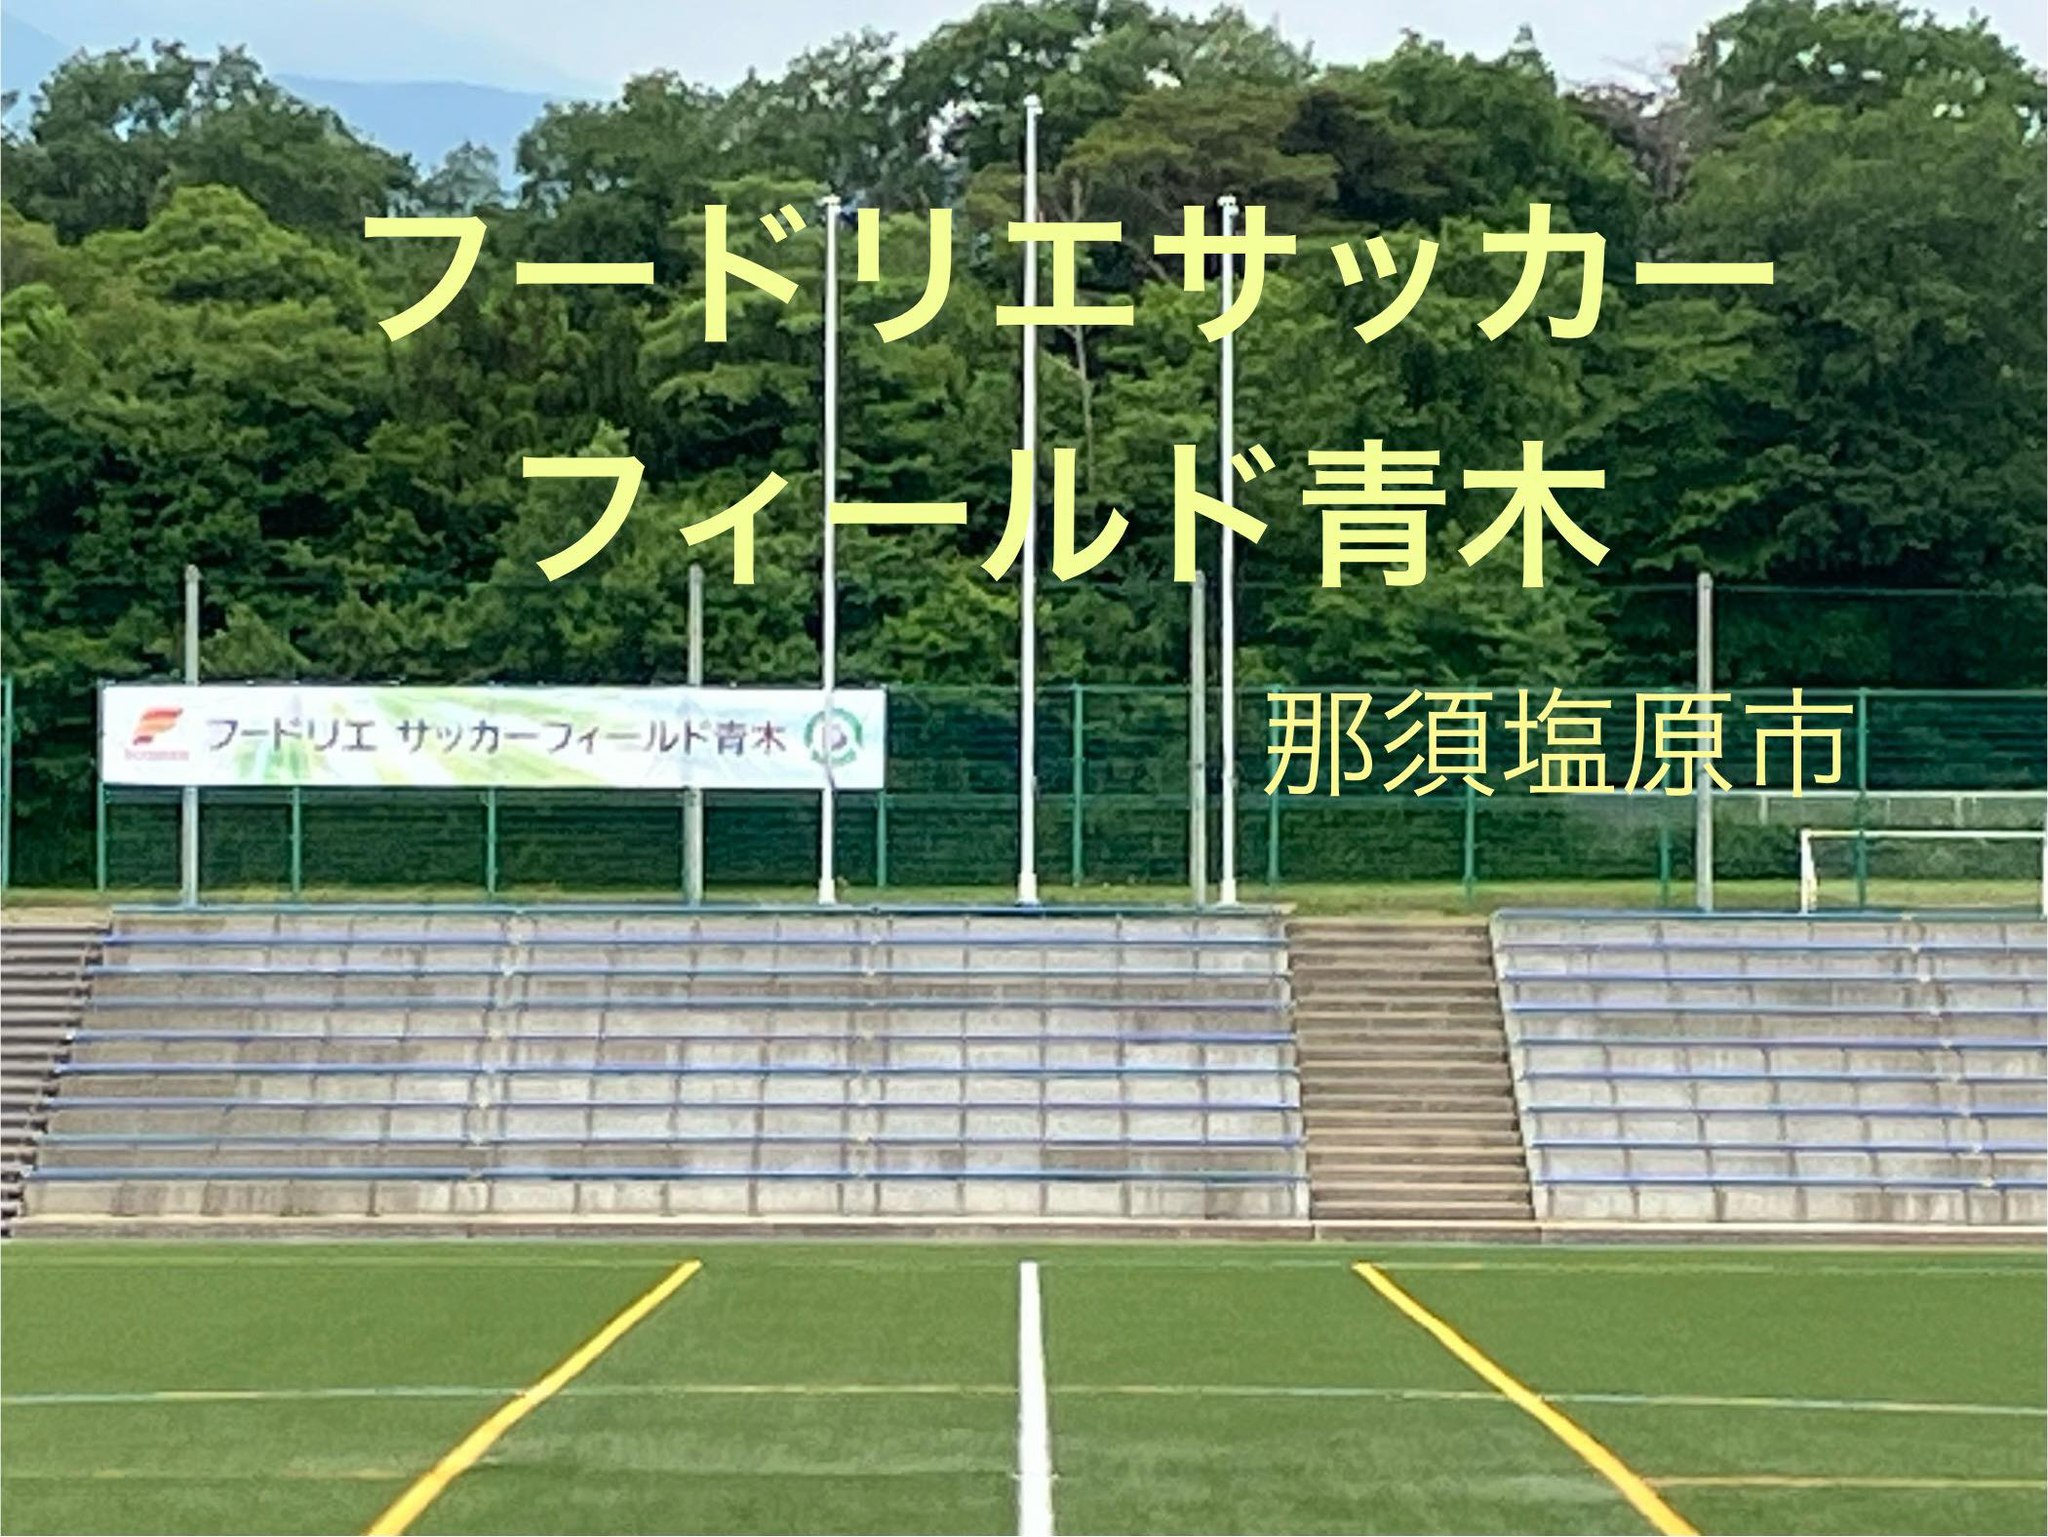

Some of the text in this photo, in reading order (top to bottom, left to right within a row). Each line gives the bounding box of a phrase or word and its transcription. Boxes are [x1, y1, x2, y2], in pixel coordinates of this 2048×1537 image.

[206, 716, 787, 756] フードリエ サッカーフィールド青木
